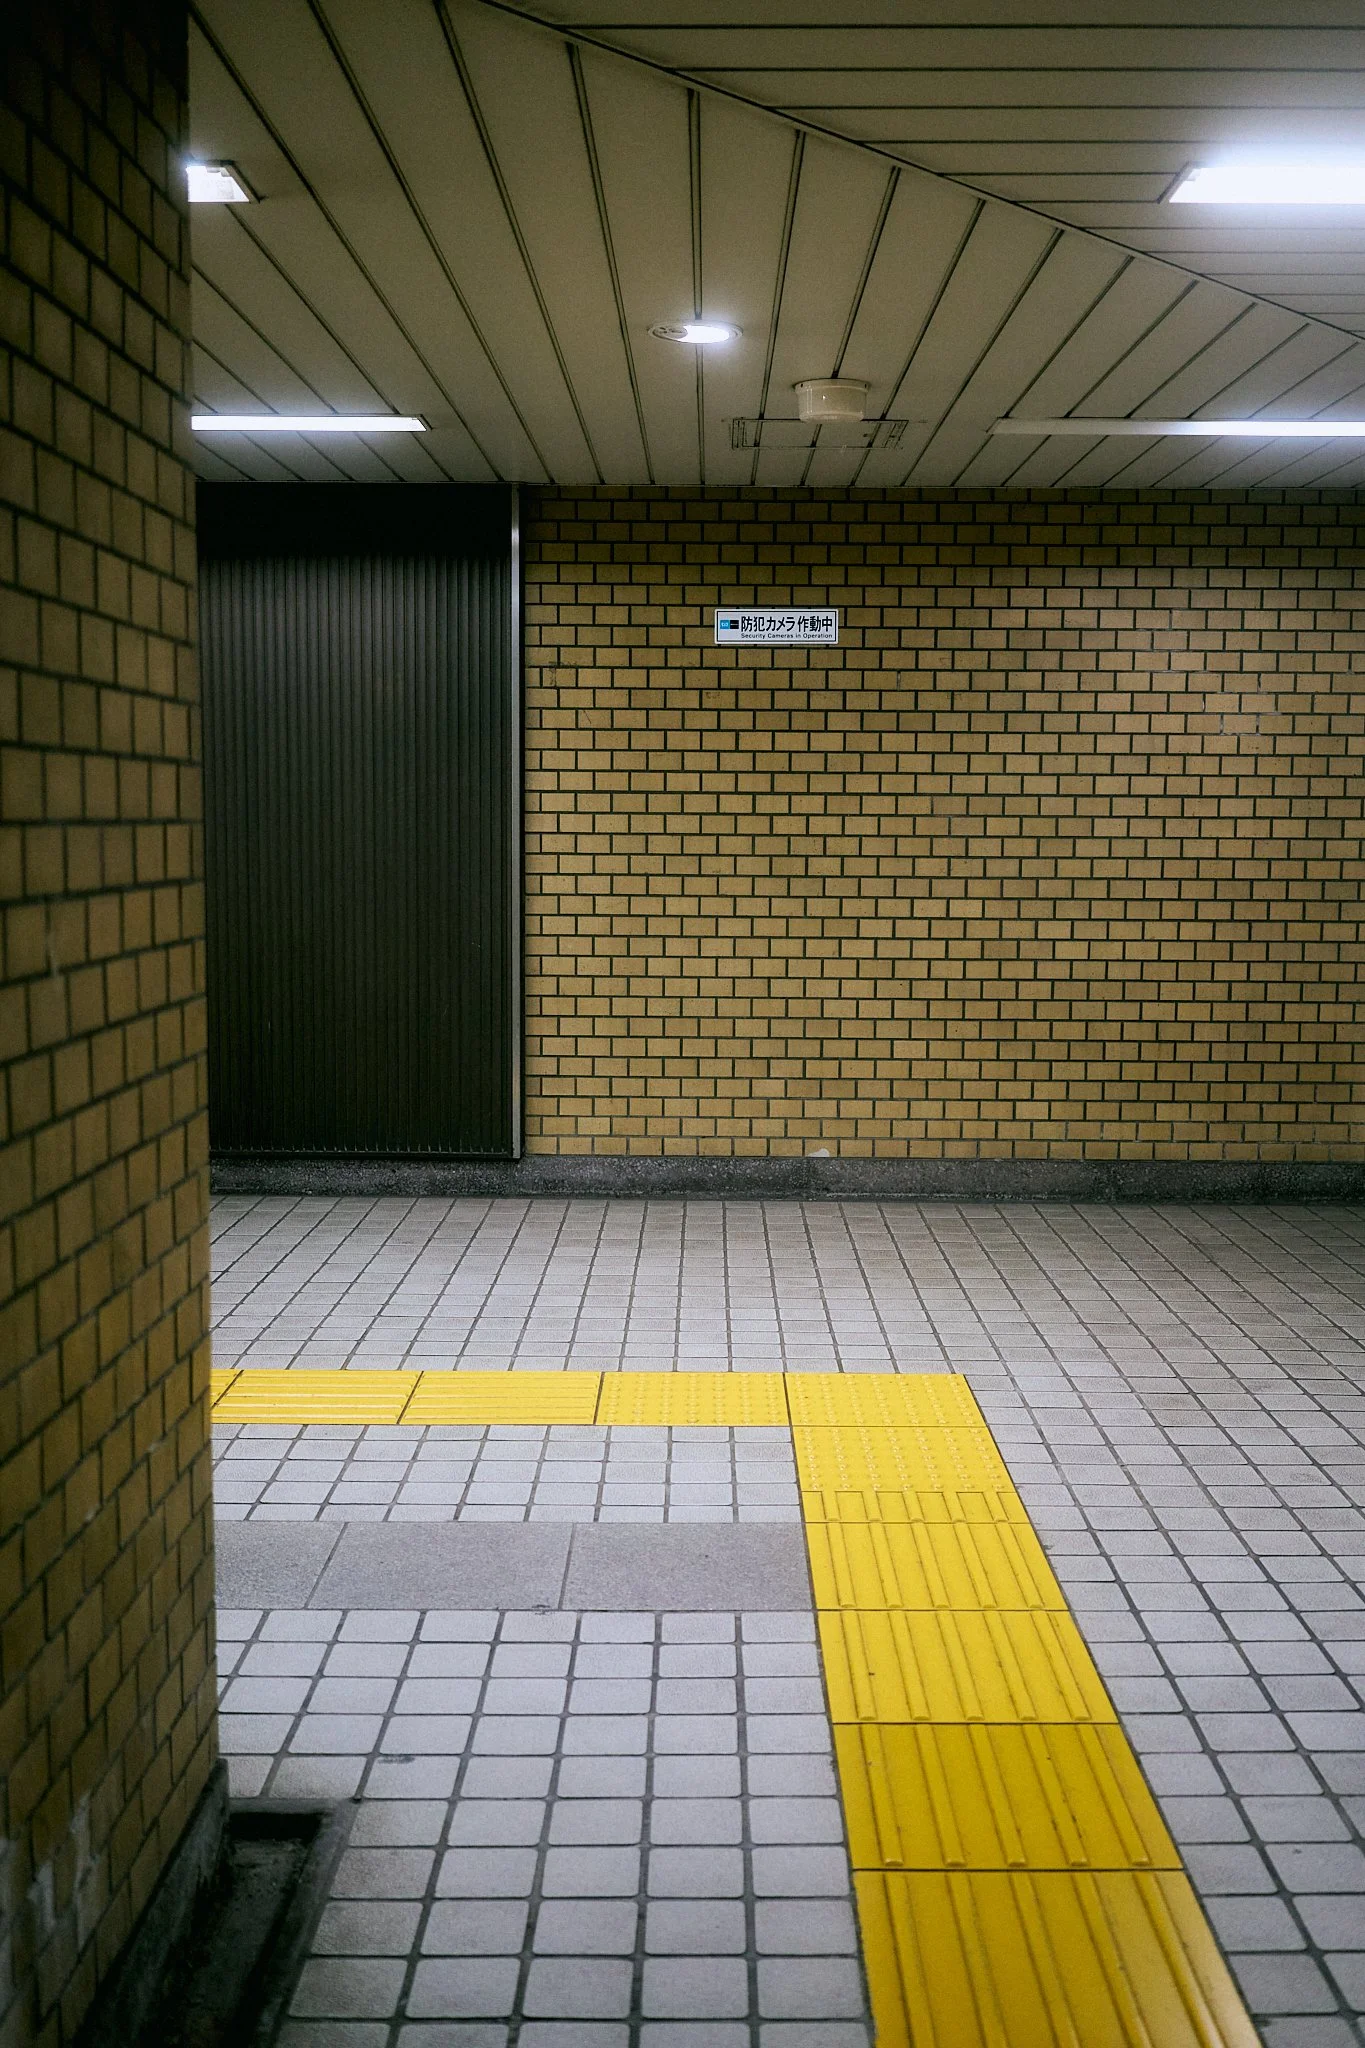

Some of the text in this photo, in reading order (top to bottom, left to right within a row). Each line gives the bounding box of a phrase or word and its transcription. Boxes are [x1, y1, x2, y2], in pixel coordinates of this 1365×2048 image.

[741, 616, 833, 632] 防犯カメラ作動中
